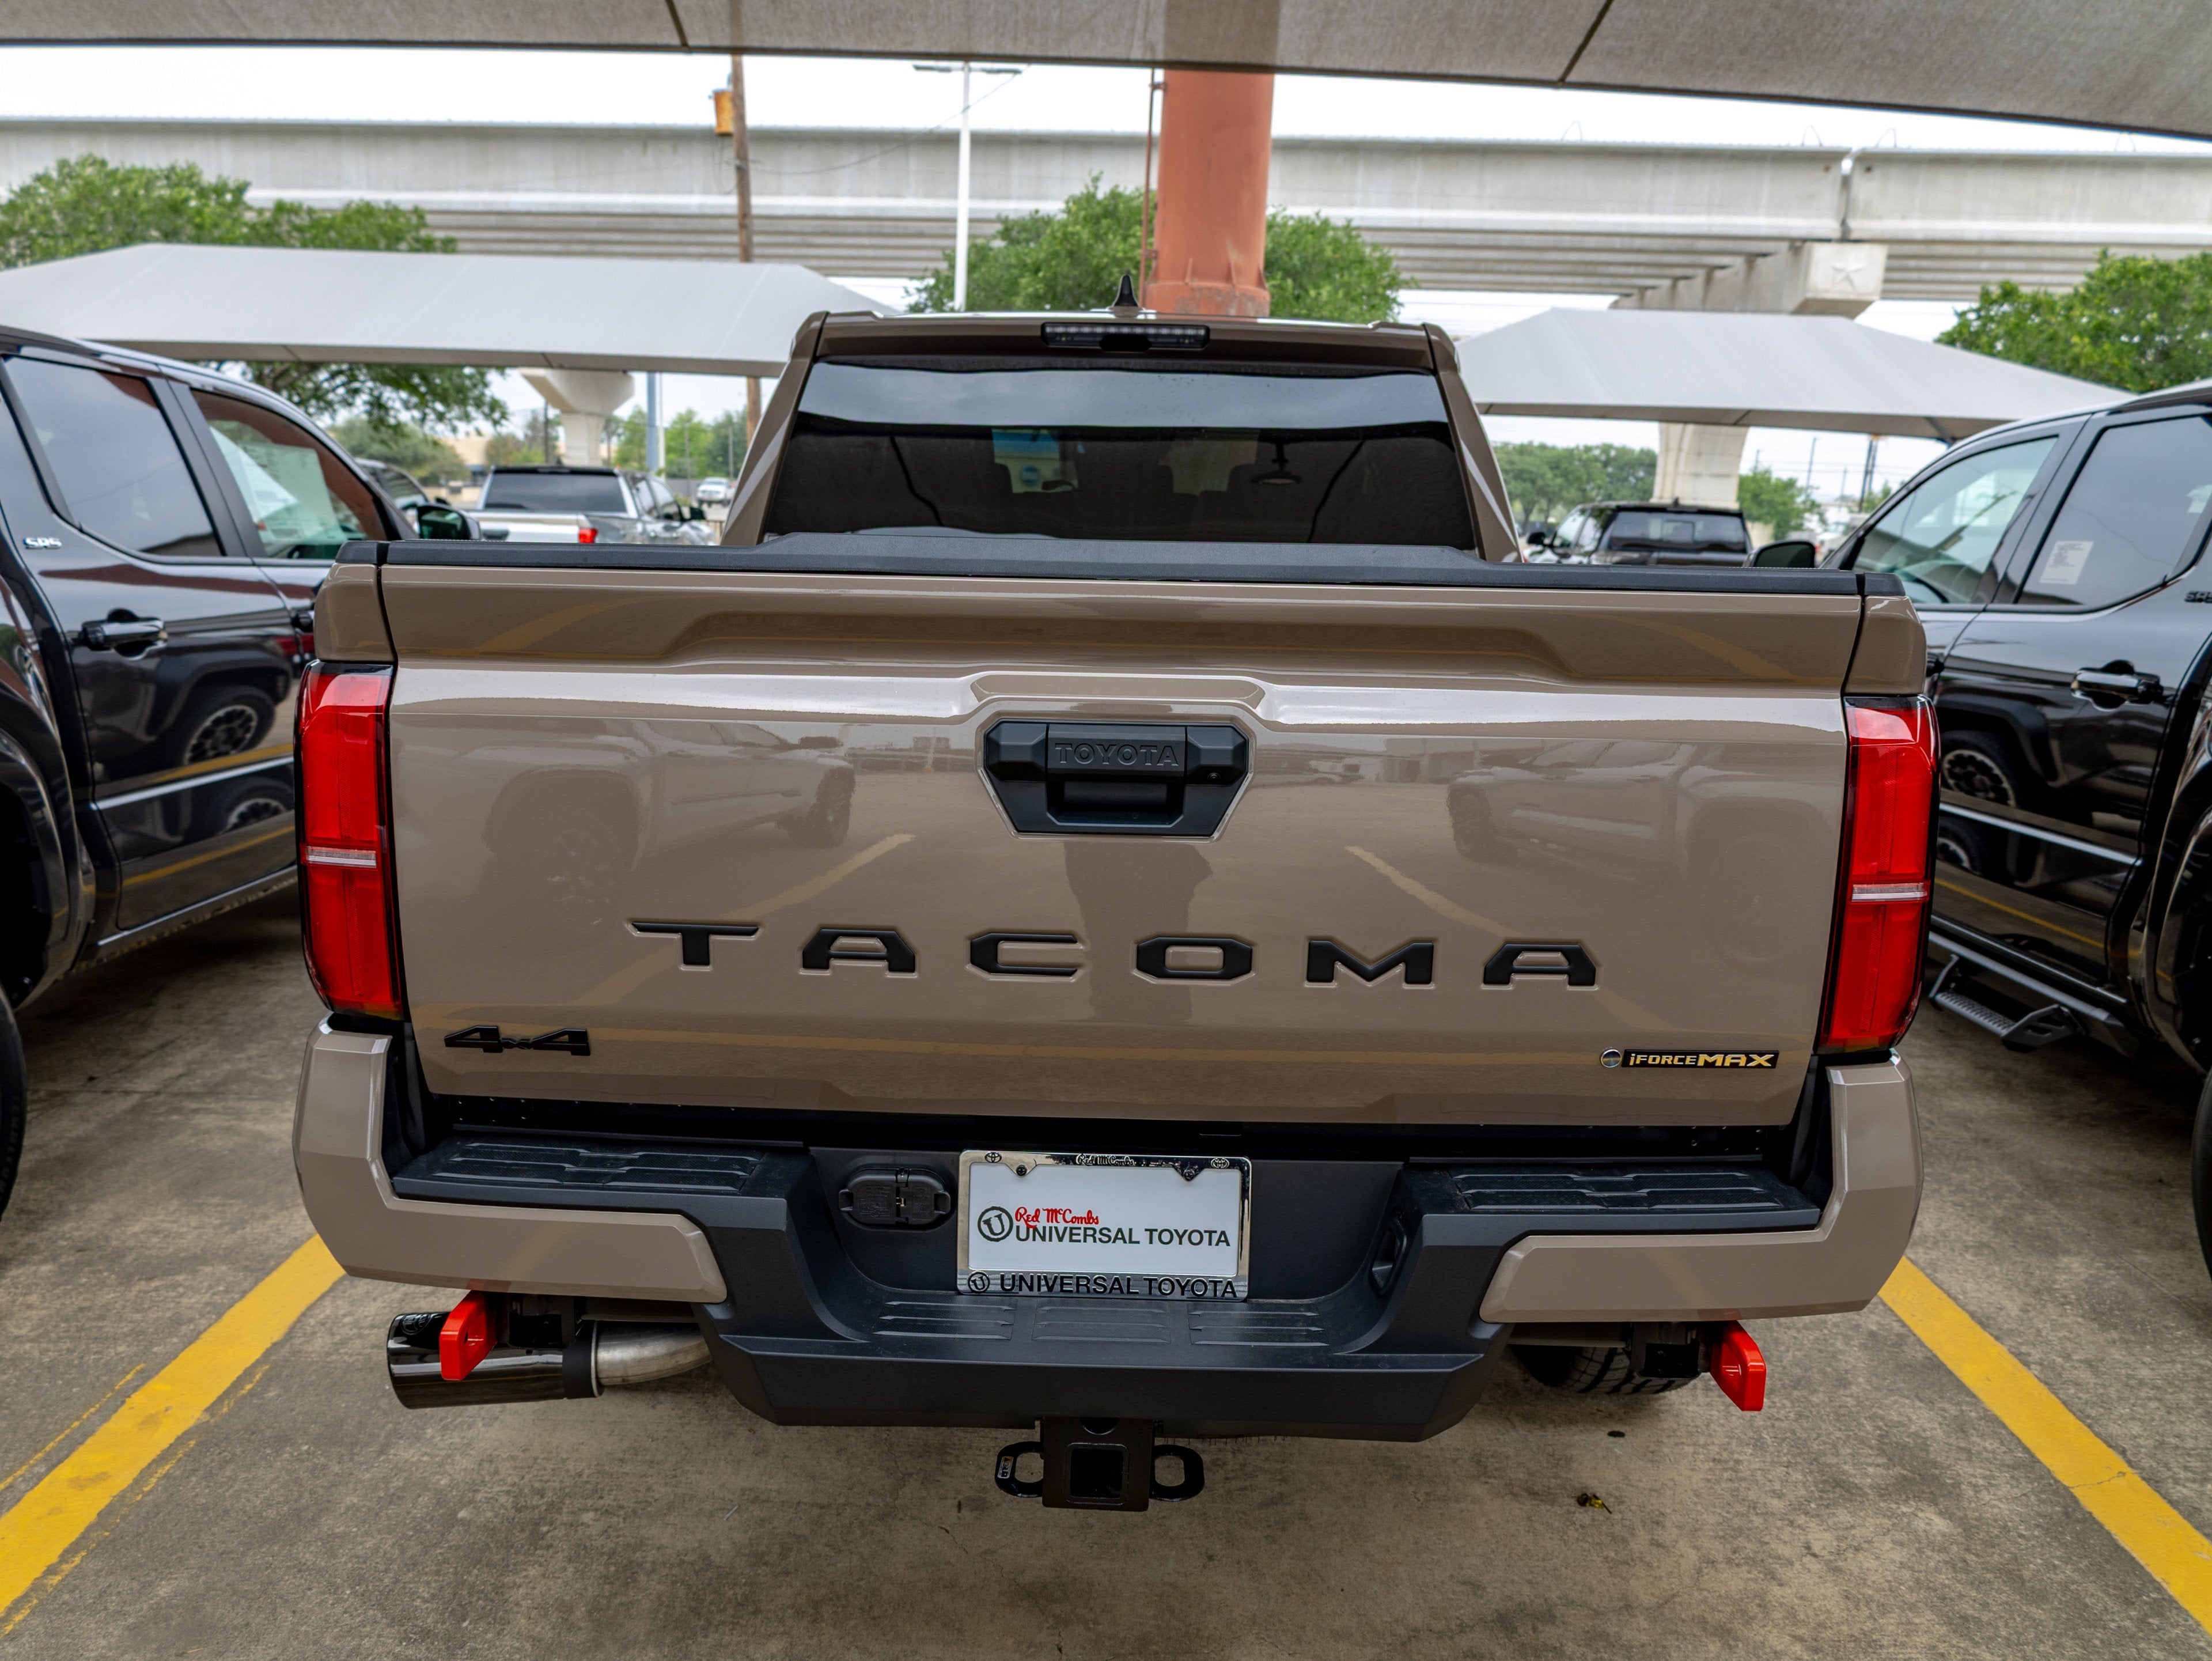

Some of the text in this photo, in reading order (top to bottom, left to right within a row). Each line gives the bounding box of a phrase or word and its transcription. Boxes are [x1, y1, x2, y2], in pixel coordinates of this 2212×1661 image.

[1055, 743, 1179, 766] TOYOTA
[629, 921, 1599, 989] TACOMA
[1075, 1153, 1096, 1166] Red
[1015, 1206, 1099, 1229] Red McCombs
[1016, 1225, 1230, 1247] UNIVERSAL TOYOTA
[999, 1273, 1238, 1297] UNIVERSAL TOYOTA
